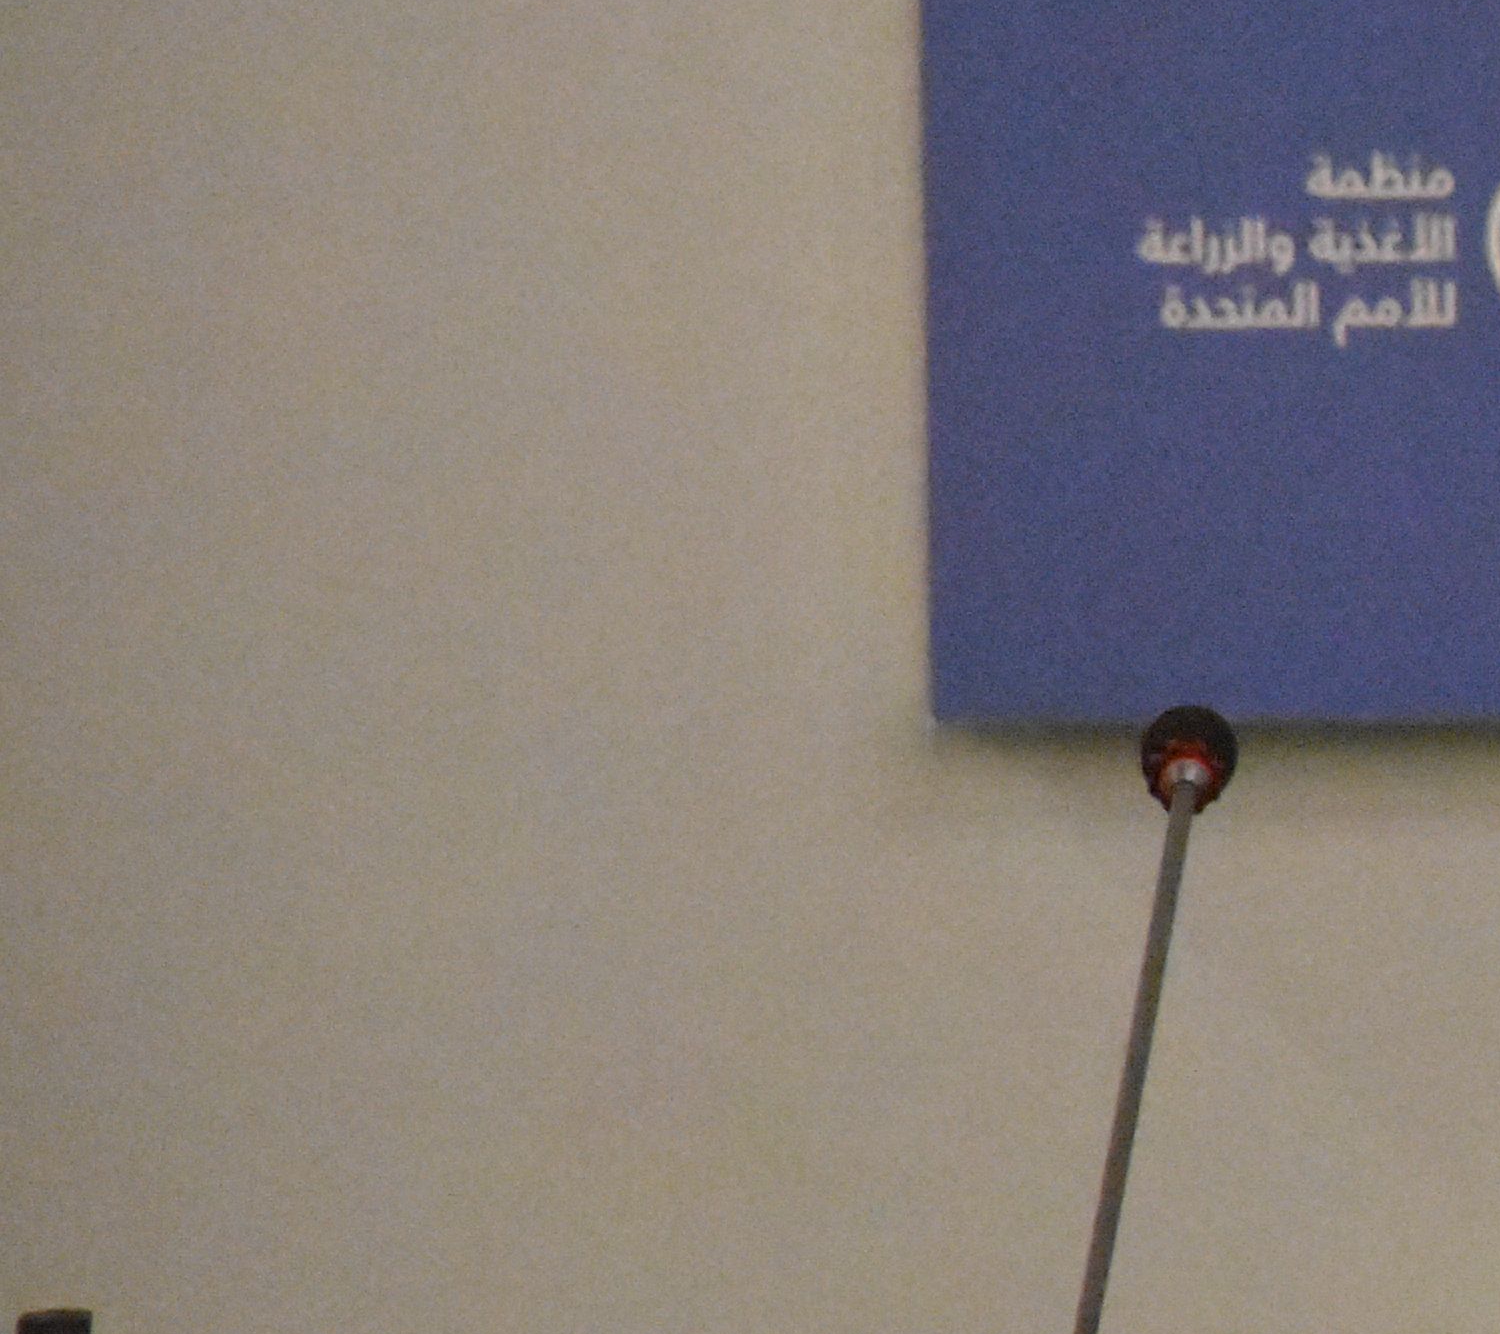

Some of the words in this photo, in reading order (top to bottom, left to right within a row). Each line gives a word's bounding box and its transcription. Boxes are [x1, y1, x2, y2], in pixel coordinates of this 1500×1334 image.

[1305, 151, 1456, 200] منظمة
[1138, 217, 1295, 275] والزراعة
[1309, 216, 1456, 273] الأغذية
[1160, 281, 1321, 330] المتحدة
[1332, 279, 1458, 348] للأمم
